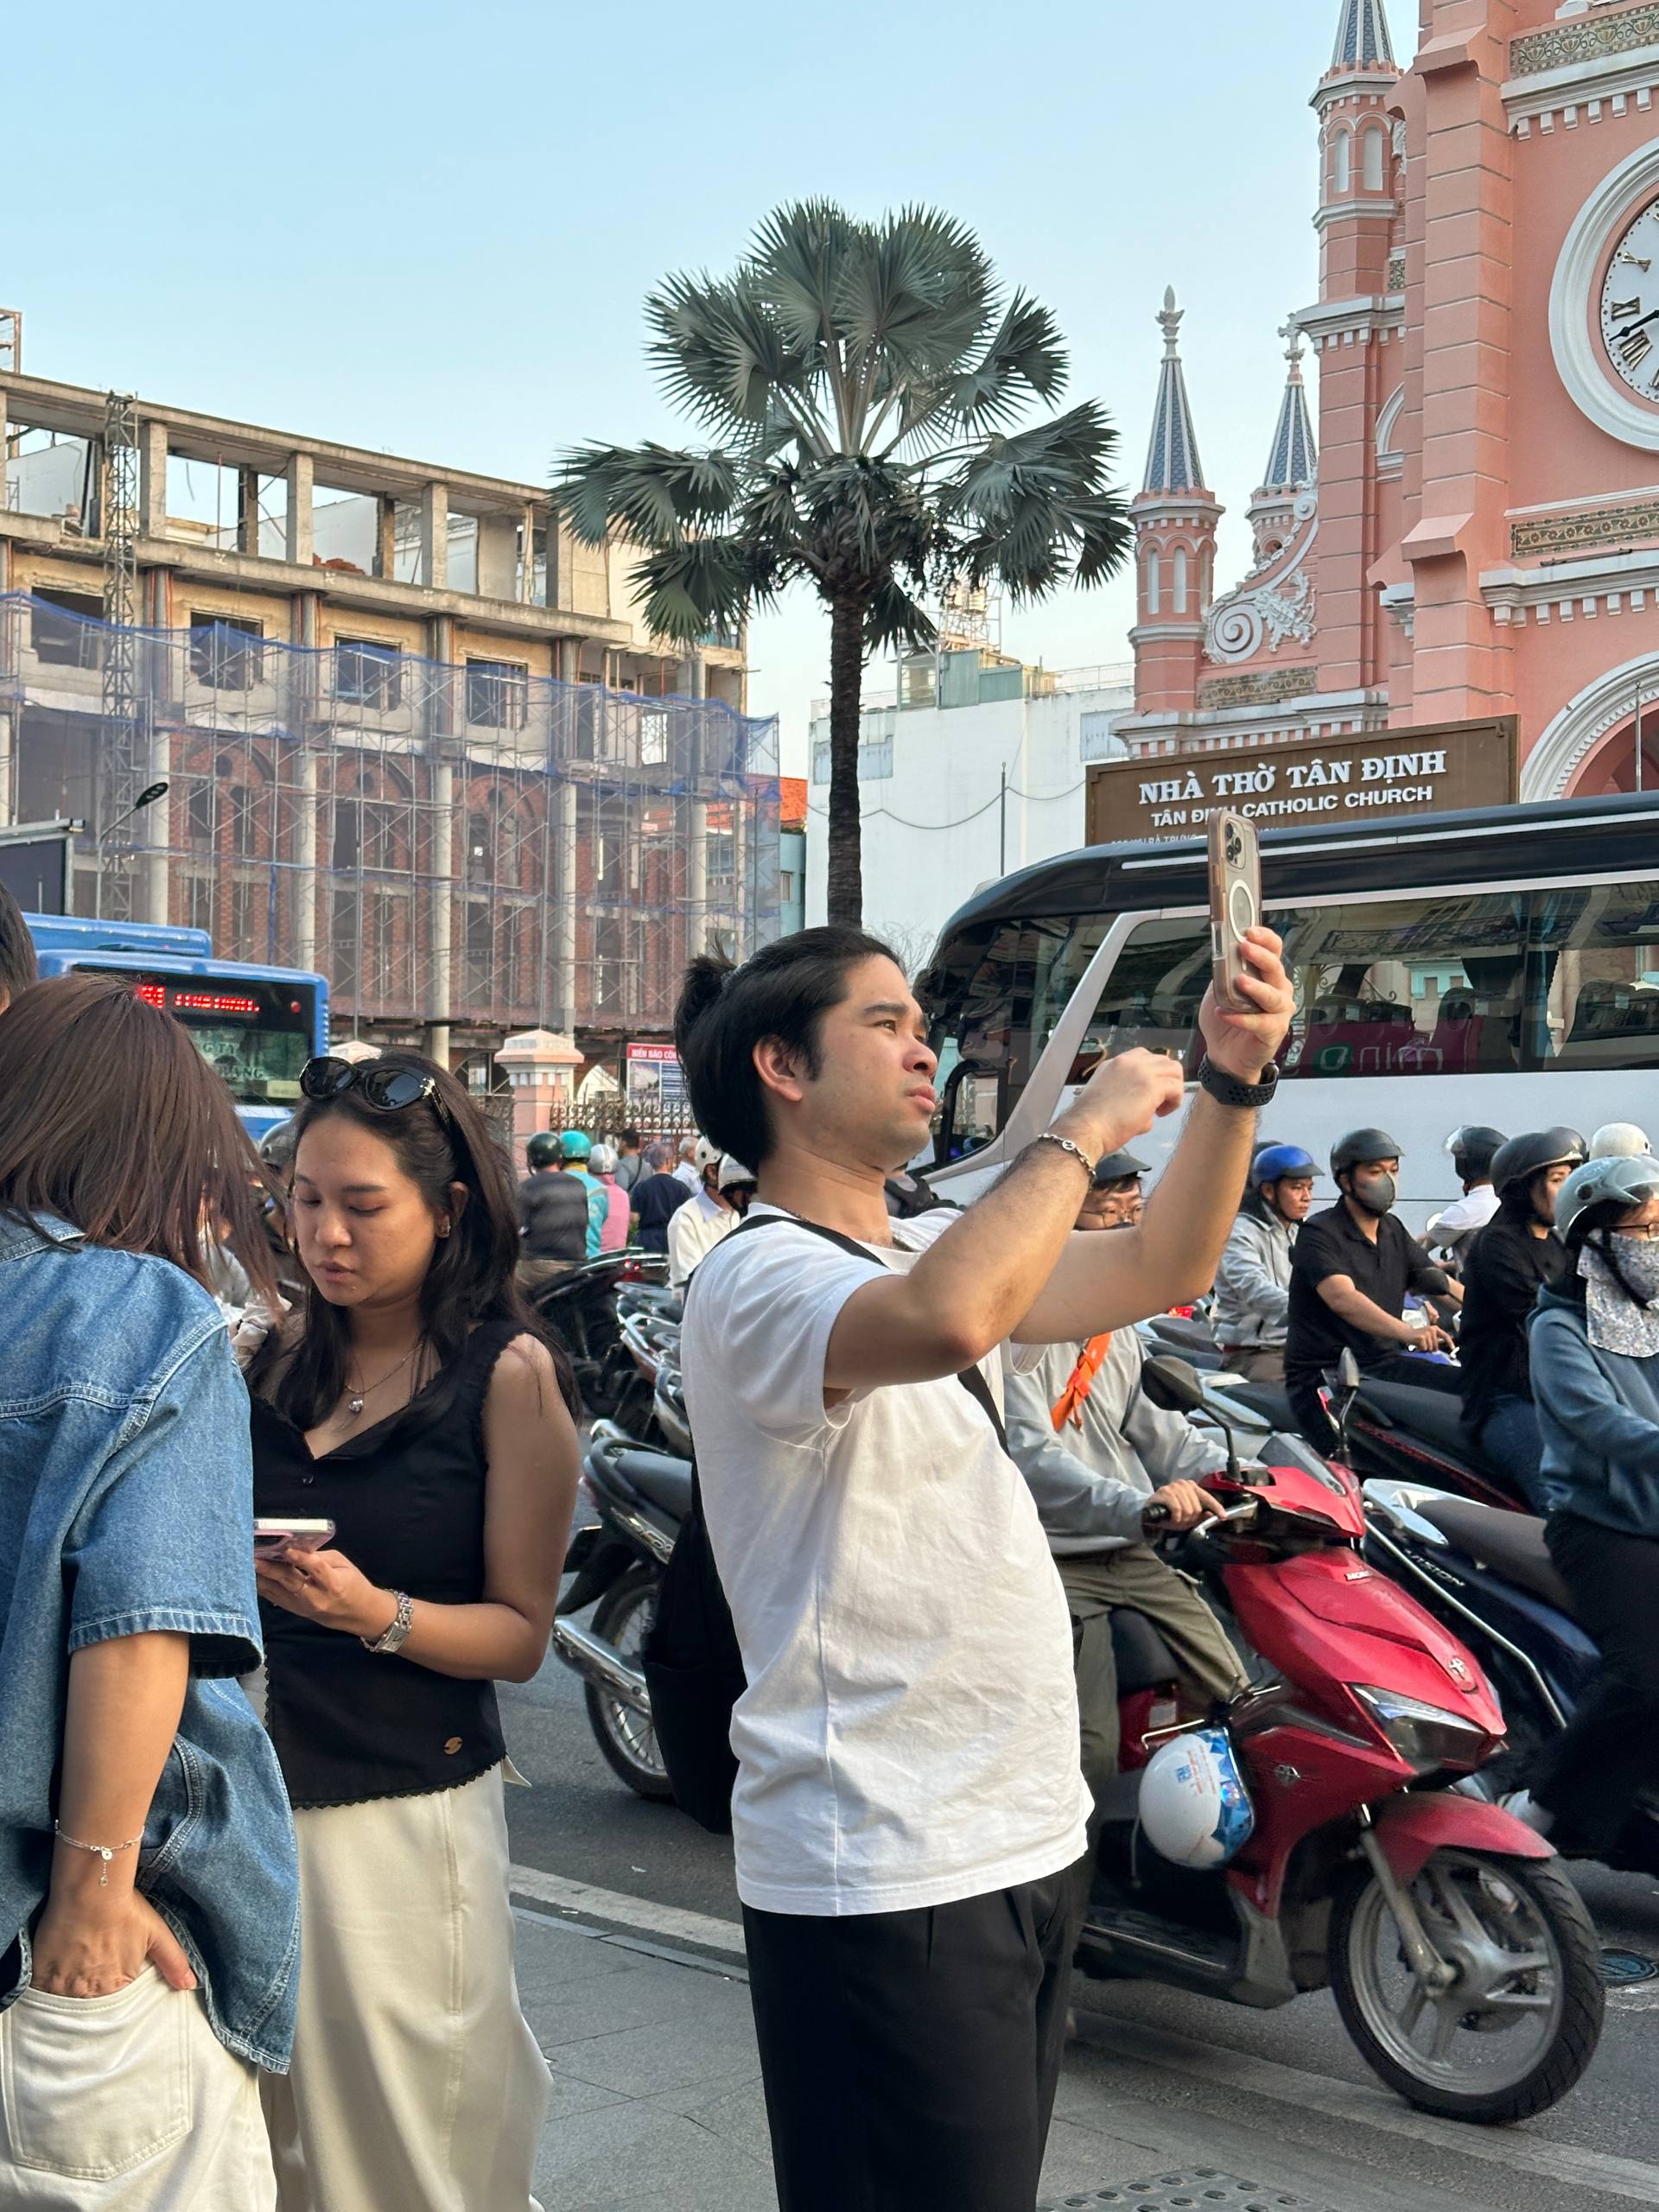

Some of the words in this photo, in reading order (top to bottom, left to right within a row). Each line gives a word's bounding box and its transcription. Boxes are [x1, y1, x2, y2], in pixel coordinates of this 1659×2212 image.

[1139, 771, 1204, 805] NHÀ
[1211, 762, 1276, 798] THỜ
[1285, 758, 1353, 788] TÂN
[1361, 750, 1447, 785] ĐỊNH
[1151, 809, 1187, 828] TÂN
[1191, 805, 1236, 826] ĐỊ
[1243, 794, 1339, 819] CATHOLIC
[1344, 785, 1434, 809] CHURCH
